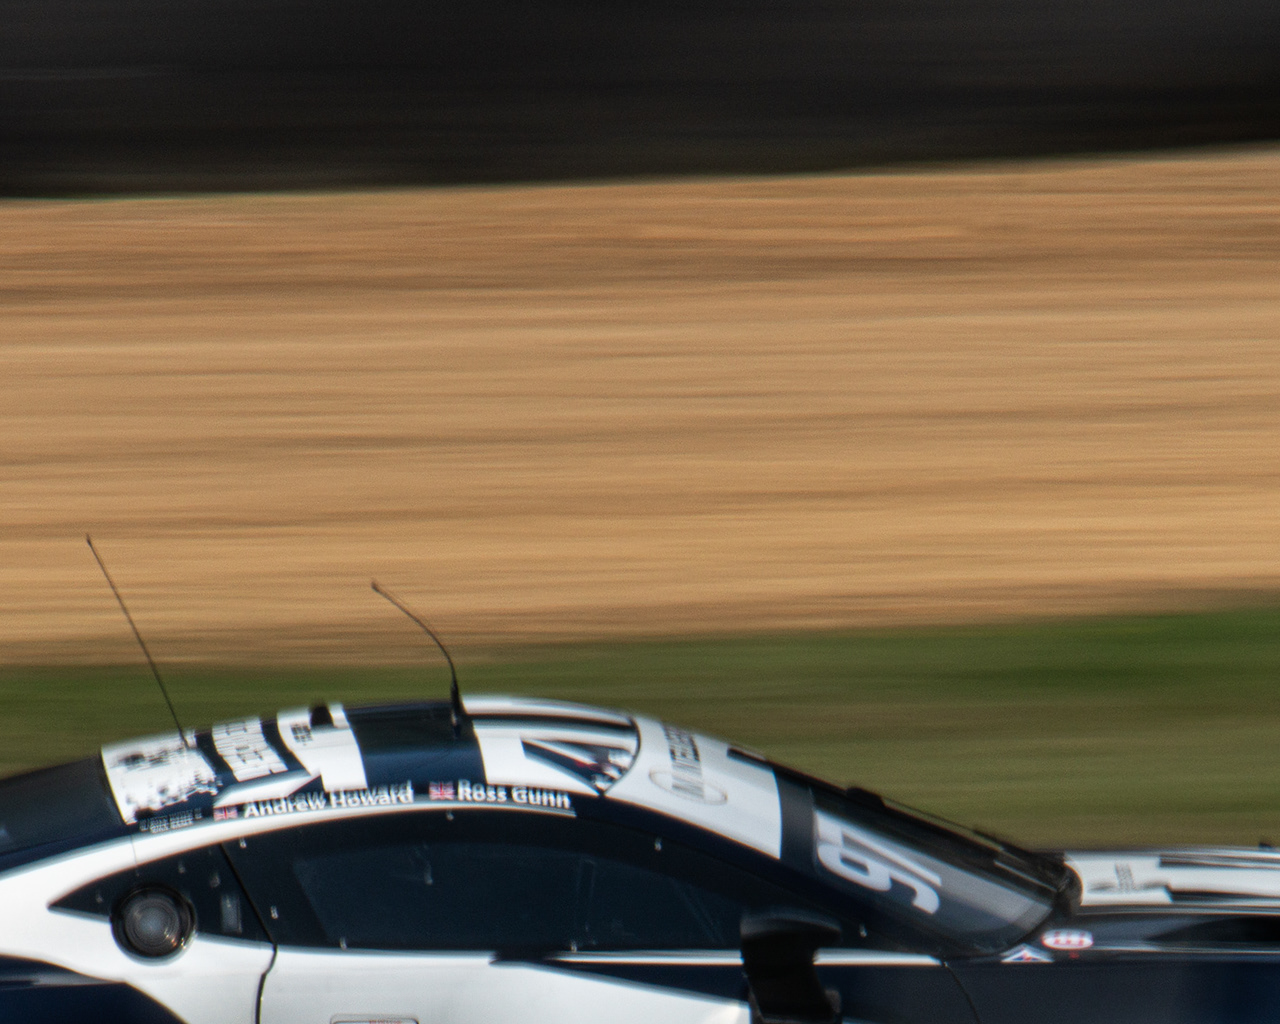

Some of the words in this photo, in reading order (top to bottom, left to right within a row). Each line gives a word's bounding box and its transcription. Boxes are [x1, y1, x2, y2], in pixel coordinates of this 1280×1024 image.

[243, 793, 326, 819] Andrew
[329, 784, 415, 809] Howard
[457, 782, 507, 804] Ross
[511, 787, 571, 808] Gunn
